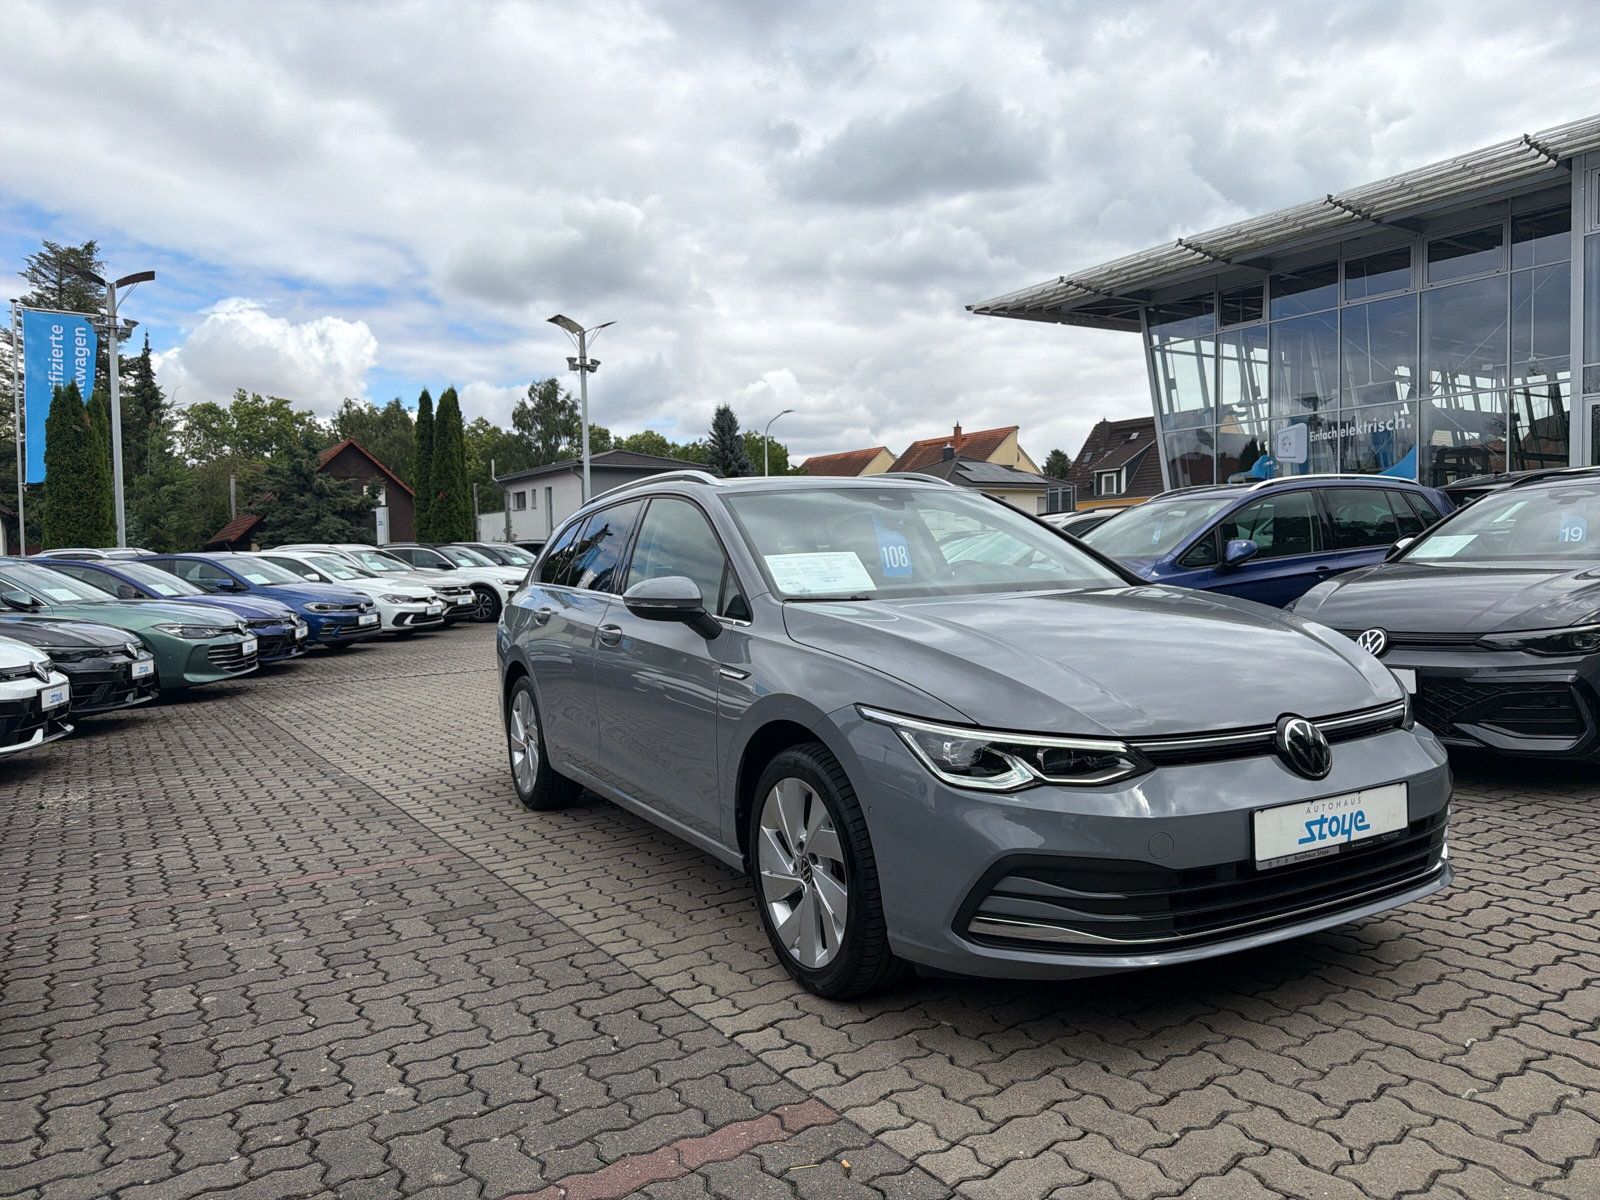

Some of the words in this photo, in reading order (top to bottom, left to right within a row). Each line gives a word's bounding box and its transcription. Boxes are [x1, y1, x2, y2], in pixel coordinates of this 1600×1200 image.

[48, 325, 64, 397] ifizierte
[75, 327, 91, 400] twagen
[1310, 426, 1337, 442] Einfach
[1340, 410, 1412, 438] elektrisch.
[1562, 527, 1583, 542] 19
[882, 546, 908, 568] 108
[1306, 796, 1362, 815] AUTOHAUS
